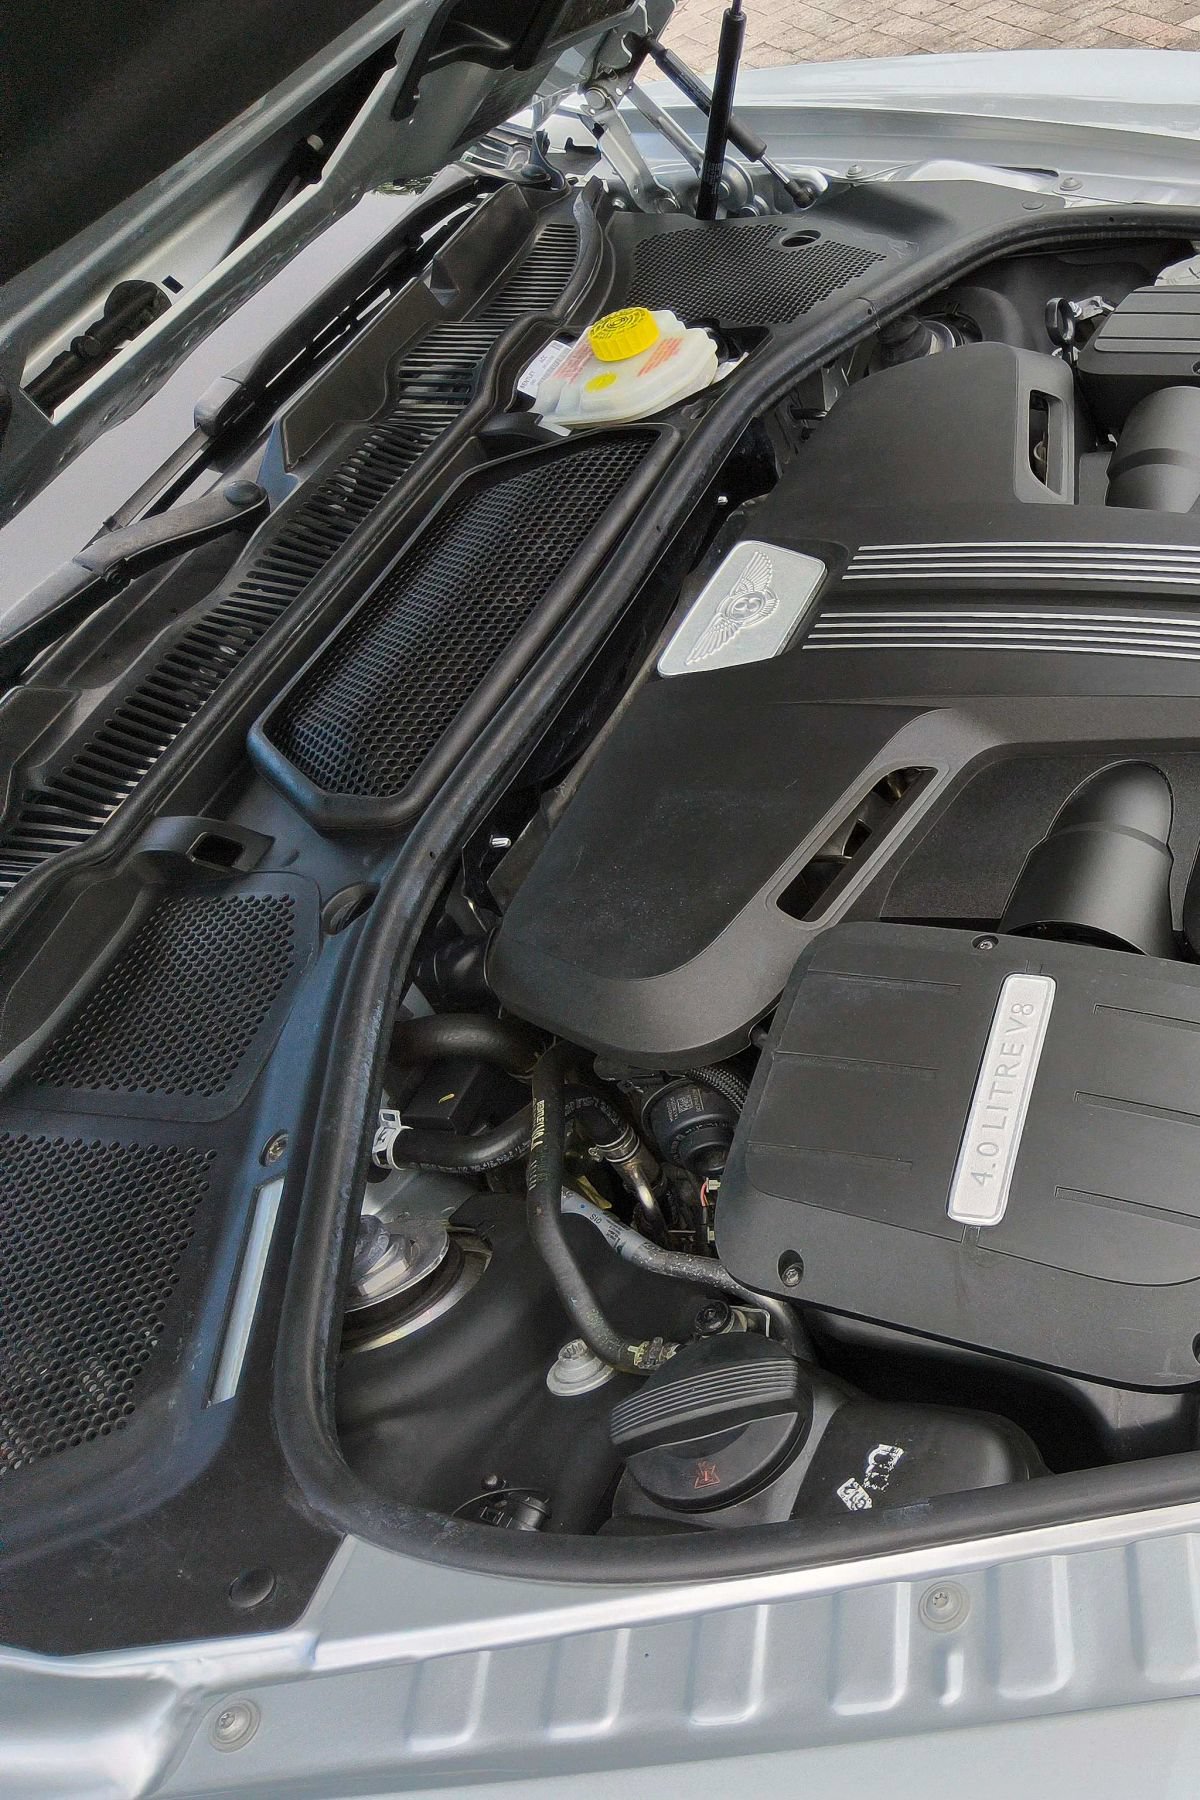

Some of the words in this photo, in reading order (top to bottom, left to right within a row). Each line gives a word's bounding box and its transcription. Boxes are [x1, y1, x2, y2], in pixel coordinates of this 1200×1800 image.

[1004, 1002, 1035, 1035] V8
[981, 1043, 1025, 1131] LITRE
[970, 1141, 1000, 1187] 4.0
